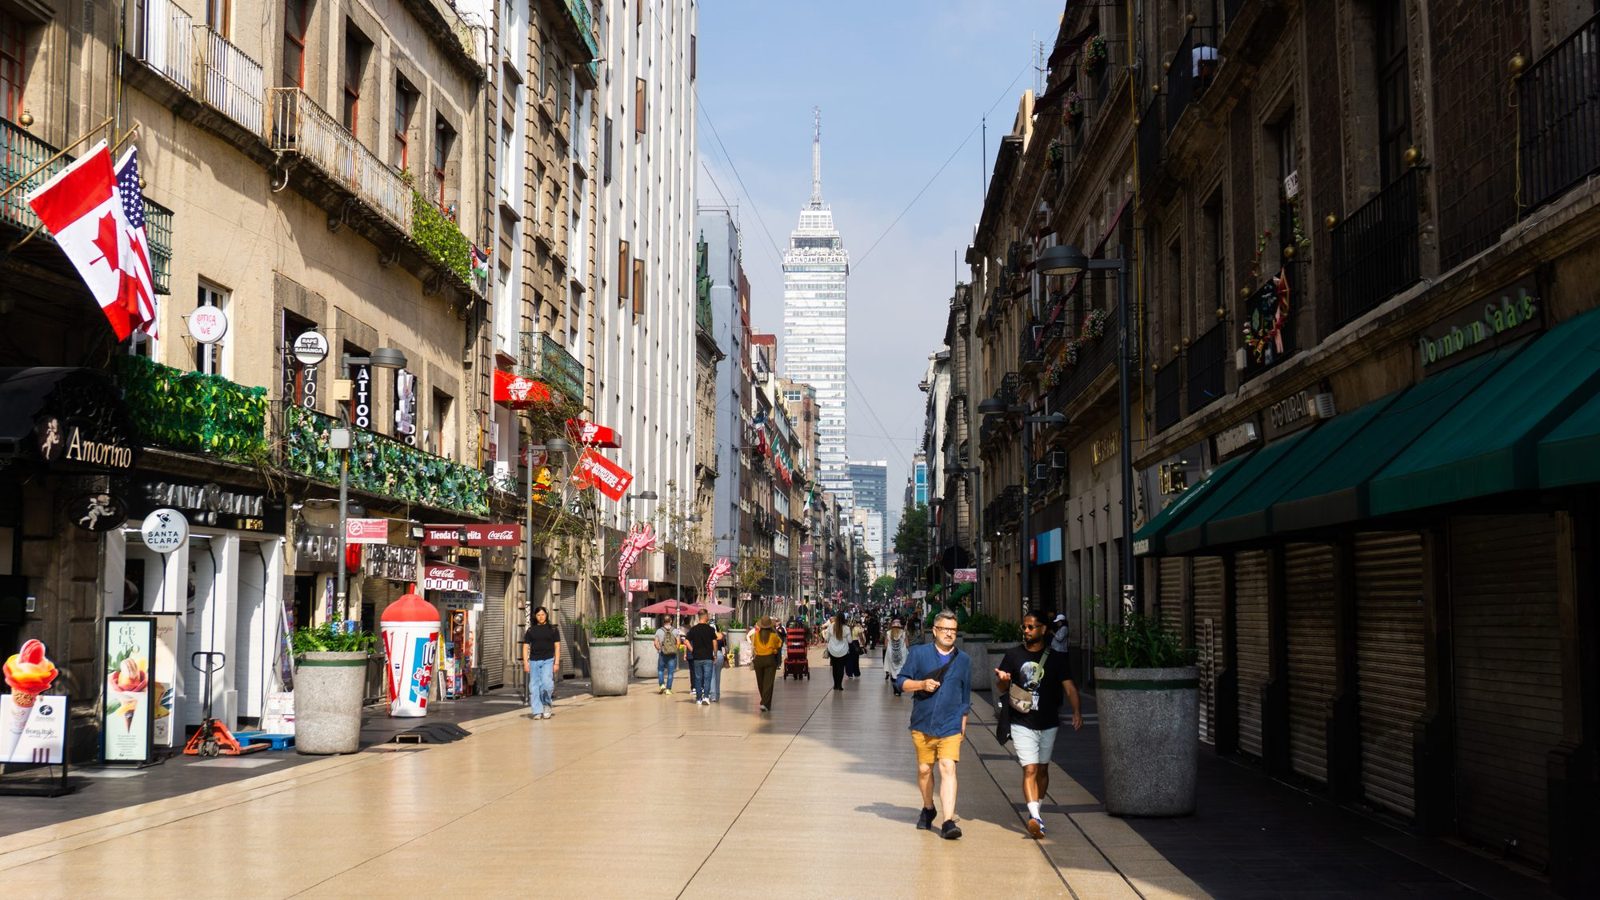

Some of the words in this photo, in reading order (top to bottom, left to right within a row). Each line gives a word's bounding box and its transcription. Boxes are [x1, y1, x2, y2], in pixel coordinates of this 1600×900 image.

[356, 364, 369, 428] ATTOO
[66, 426, 131, 468] Amorino
[430, 530, 451, 540] Tienda
[451, 530, 481, 540] Caelita
